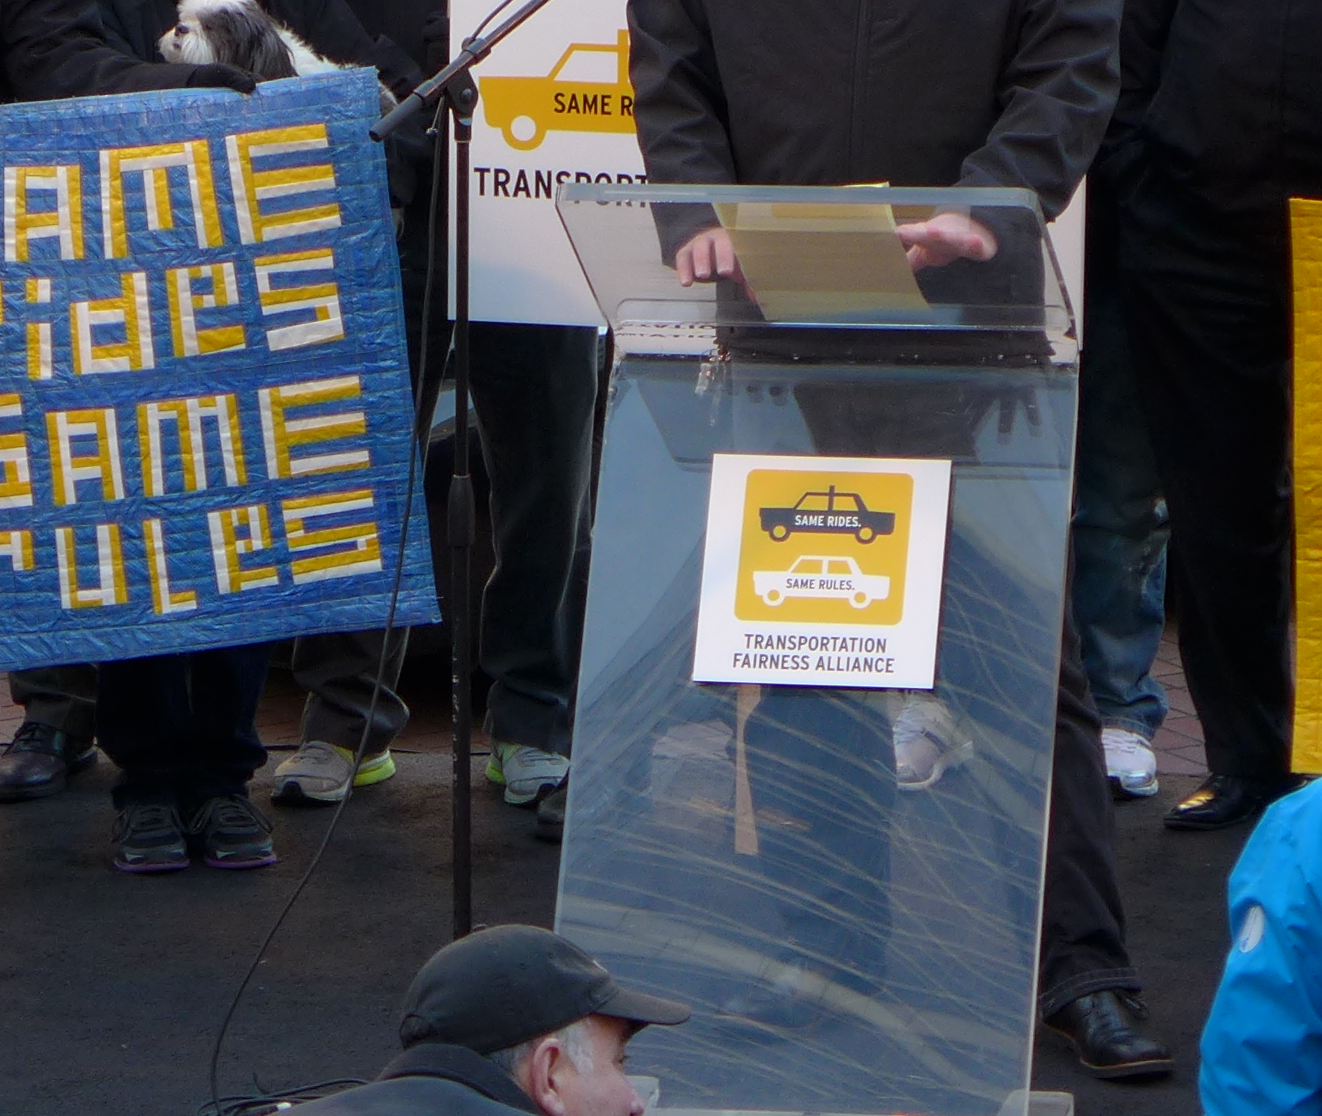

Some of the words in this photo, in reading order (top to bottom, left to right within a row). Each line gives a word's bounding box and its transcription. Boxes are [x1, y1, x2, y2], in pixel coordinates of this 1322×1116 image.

[553, 92, 613, 116] SAME
[619, 95, 634, 117] R
[473, 166, 649, 209] TRANSPORT
[794, 514, 825, 527] SAME
[827, 515, 862, 529] RIDES.
[786, 577, 816, 590] SAME
[818, 578, 856, 592] RULES.
[744, 633, 888, 654] TRANSPORTATION
[732, 652, 811, 671] FAIRNESS
[815, 655, 896, 674] ALLIANCE
